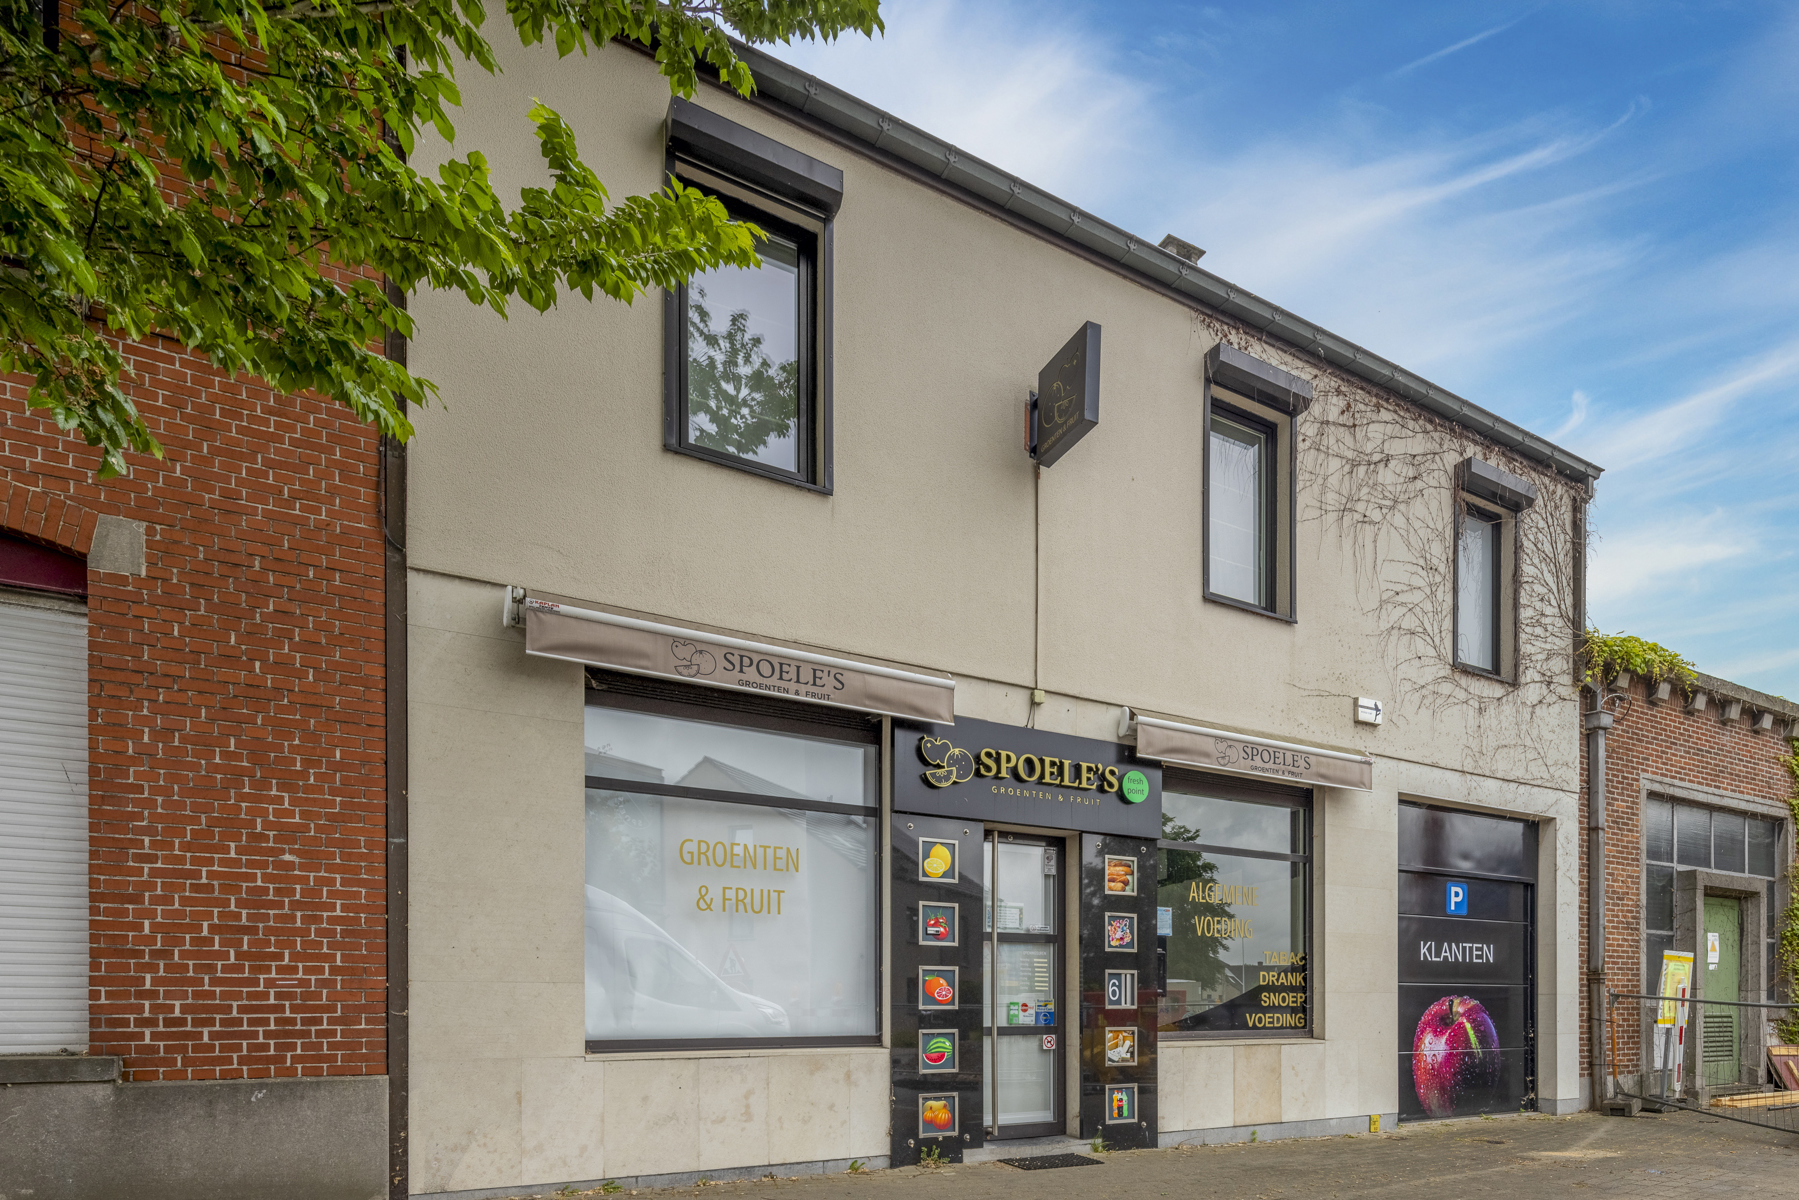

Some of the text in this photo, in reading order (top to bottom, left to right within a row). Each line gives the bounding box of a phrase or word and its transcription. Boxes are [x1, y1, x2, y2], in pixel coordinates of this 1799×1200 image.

[723, 651, 845, 691] SPOELE'S
[737, 679, 832, 701] GROENTEN & FRUIT
[1242, 745, 1311, 770] SPOELE'S
[1127, 776, 1144, 786] fresh
[1250, 765, 1280, 775] GROENTEN
[1287, 770, 1303, 778] FRUIT
[991, 785, 1101, 806] GROENTEN & FRUIT
[1127, 786, 1145, 796] point
[679, 838, 800, 873] GROENTEN
[696, 885, 785, 915] & FRUIT
[1189, 881, 1259, 907] ALGEMENE
[1450, 886, 1464, 910] P
[1195, 916, 1253, 939] VOEDING
[1263, 951, 1306, 965] TABAC
[1420, 941, 1494, 963] KLANTEN
[1259, 972, 1306, 986] DRANK
[1261, 992, 1305, 1007] SNOEP
[1246, 1013, 1305, 1028] VOEDING
